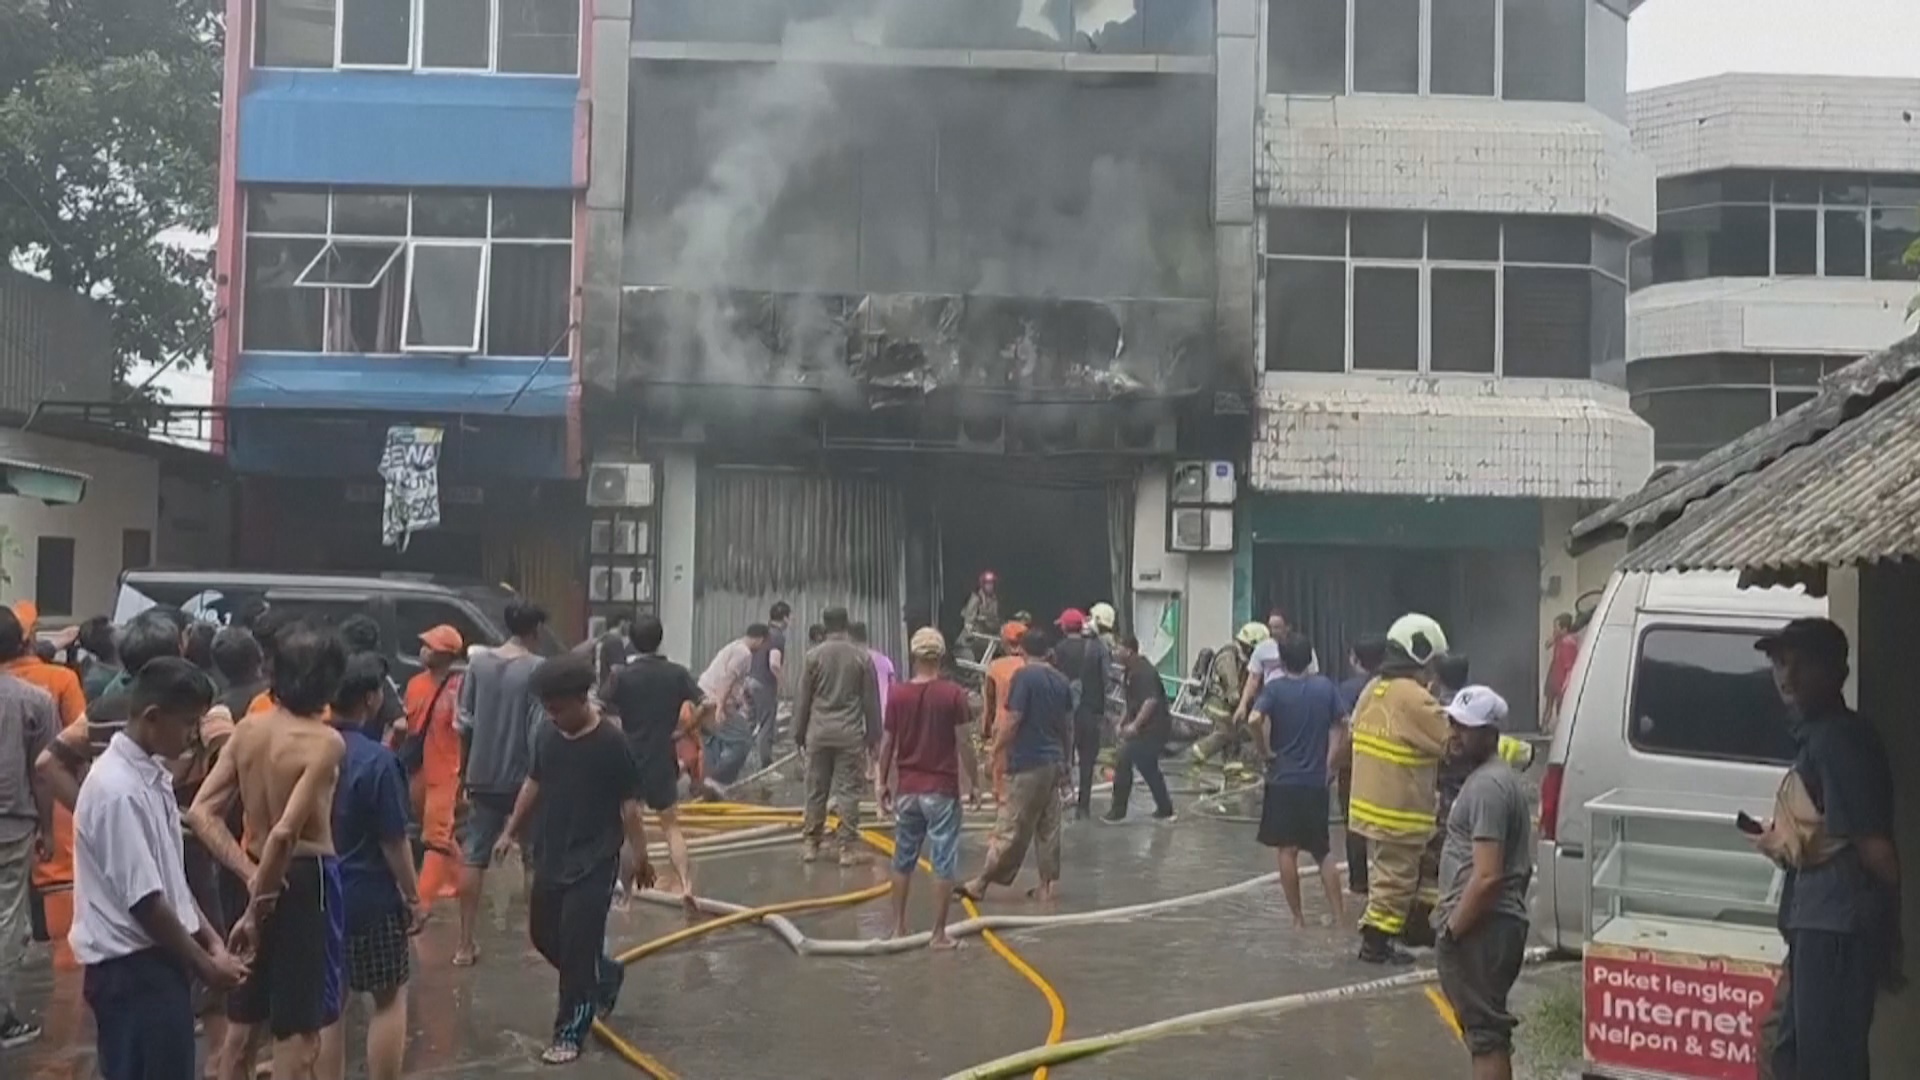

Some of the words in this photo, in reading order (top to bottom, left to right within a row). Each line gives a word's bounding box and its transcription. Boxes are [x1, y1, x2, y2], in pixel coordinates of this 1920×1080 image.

[1593, 966, 1660, 991] Paket
[1666, 976, 1764, 1008] lengkap
[1603, 992, 1753, 1036] Internet
[1589, 1022, 1678, 1050] Nelpon
[1685, 1036, 1703, 1055] &
[1710, 1040, 1756, 1063] SM
